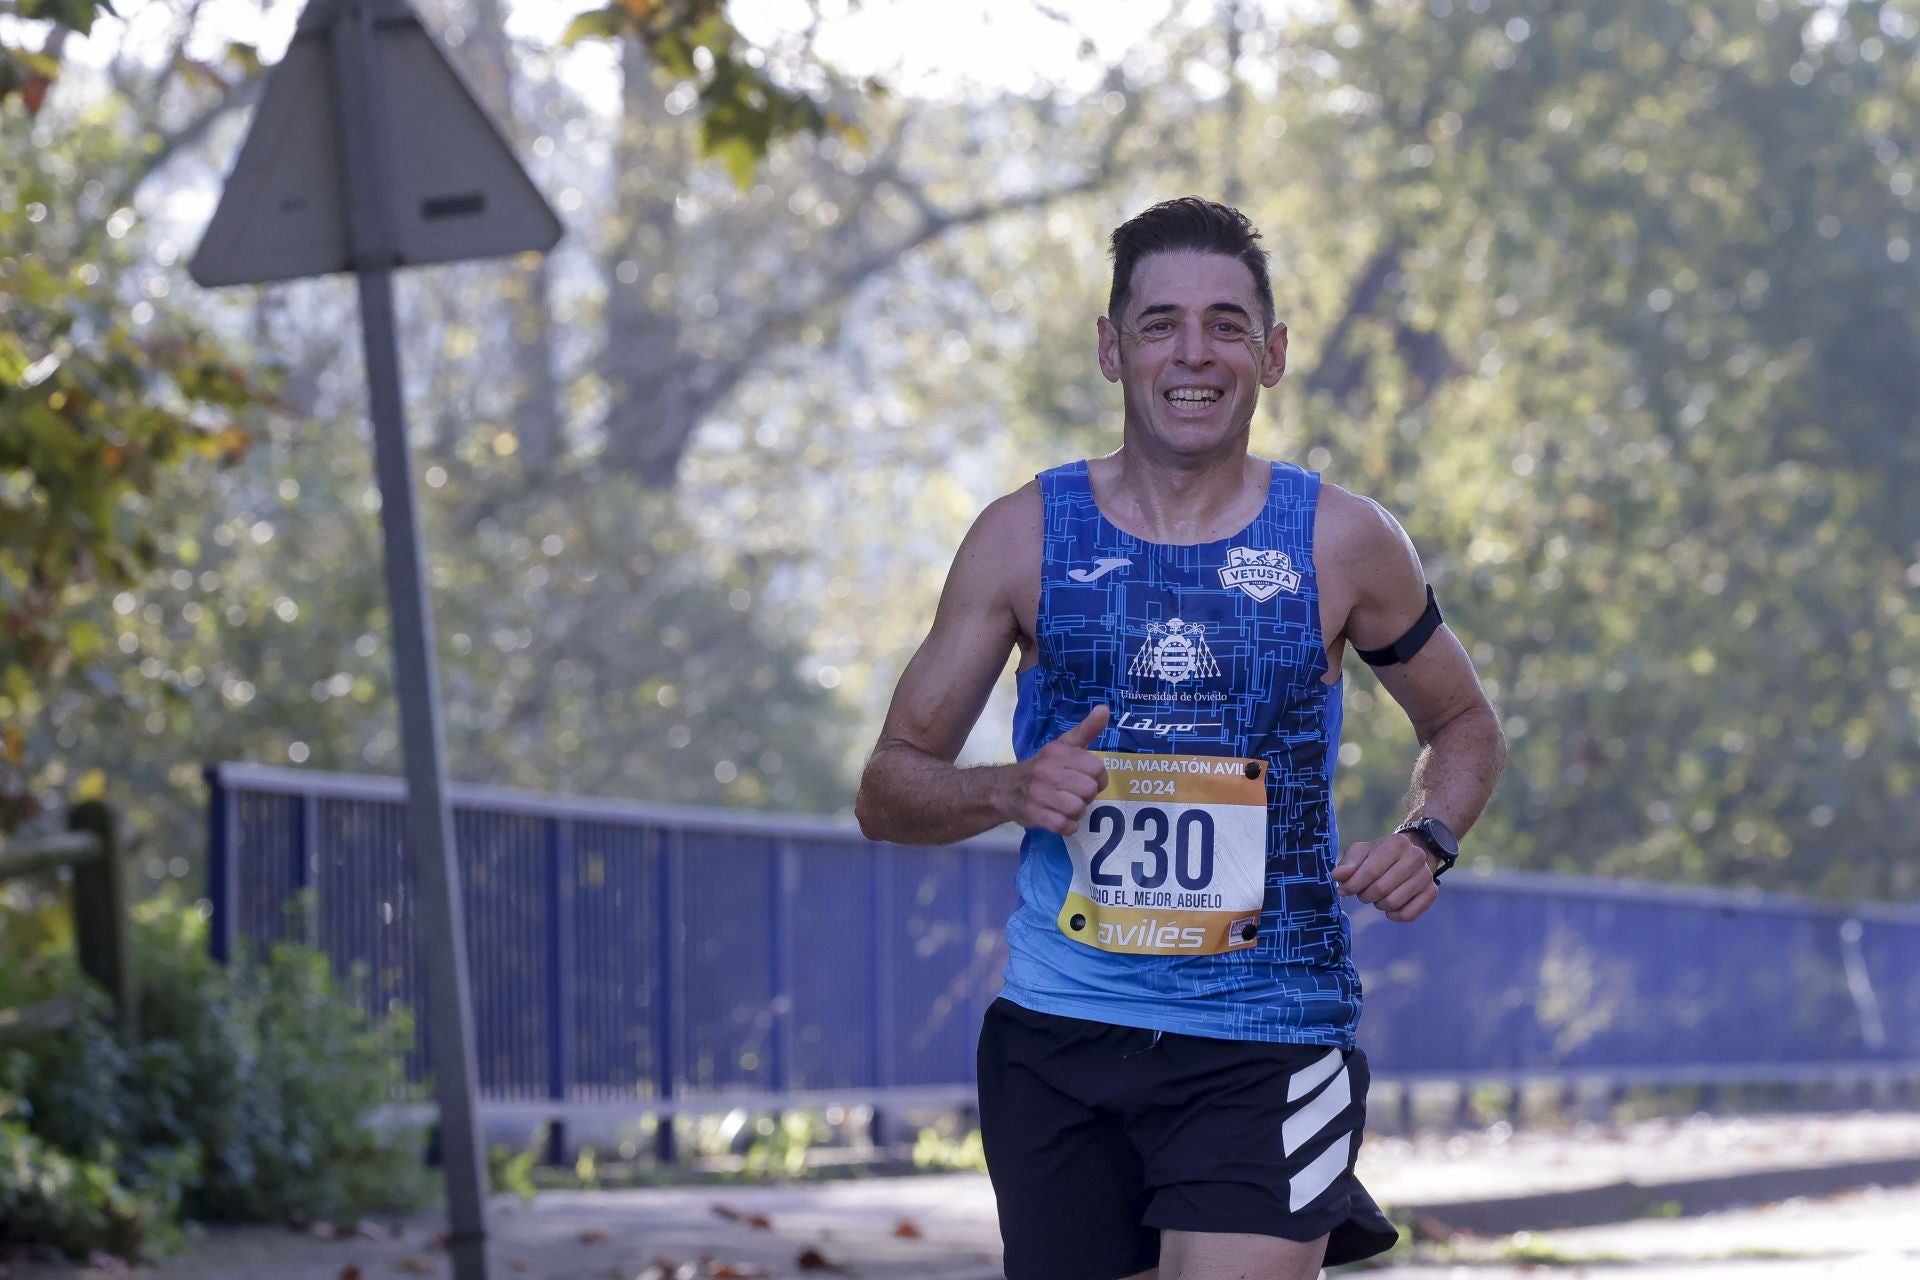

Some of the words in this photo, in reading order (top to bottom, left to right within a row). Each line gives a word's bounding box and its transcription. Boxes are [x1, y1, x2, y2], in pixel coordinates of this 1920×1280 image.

[1230, 568, 1291, 585] VETUSTA
[1120, 689, 1178, 702] Universidad
[1180, 692, 1192, 702] de
[1194, 691, 1228, 702] Oviedo
[1117, 711, 1221, 735] Lago
[1101, 757, 1133, 771] EDIA
[1137, 757, 1211, 774] MARATÓN
[1129, 779, 1176, 795] 2024
[1089, 805, 1215, 891] 230
[1097, 918, 1206, 948] avilés
